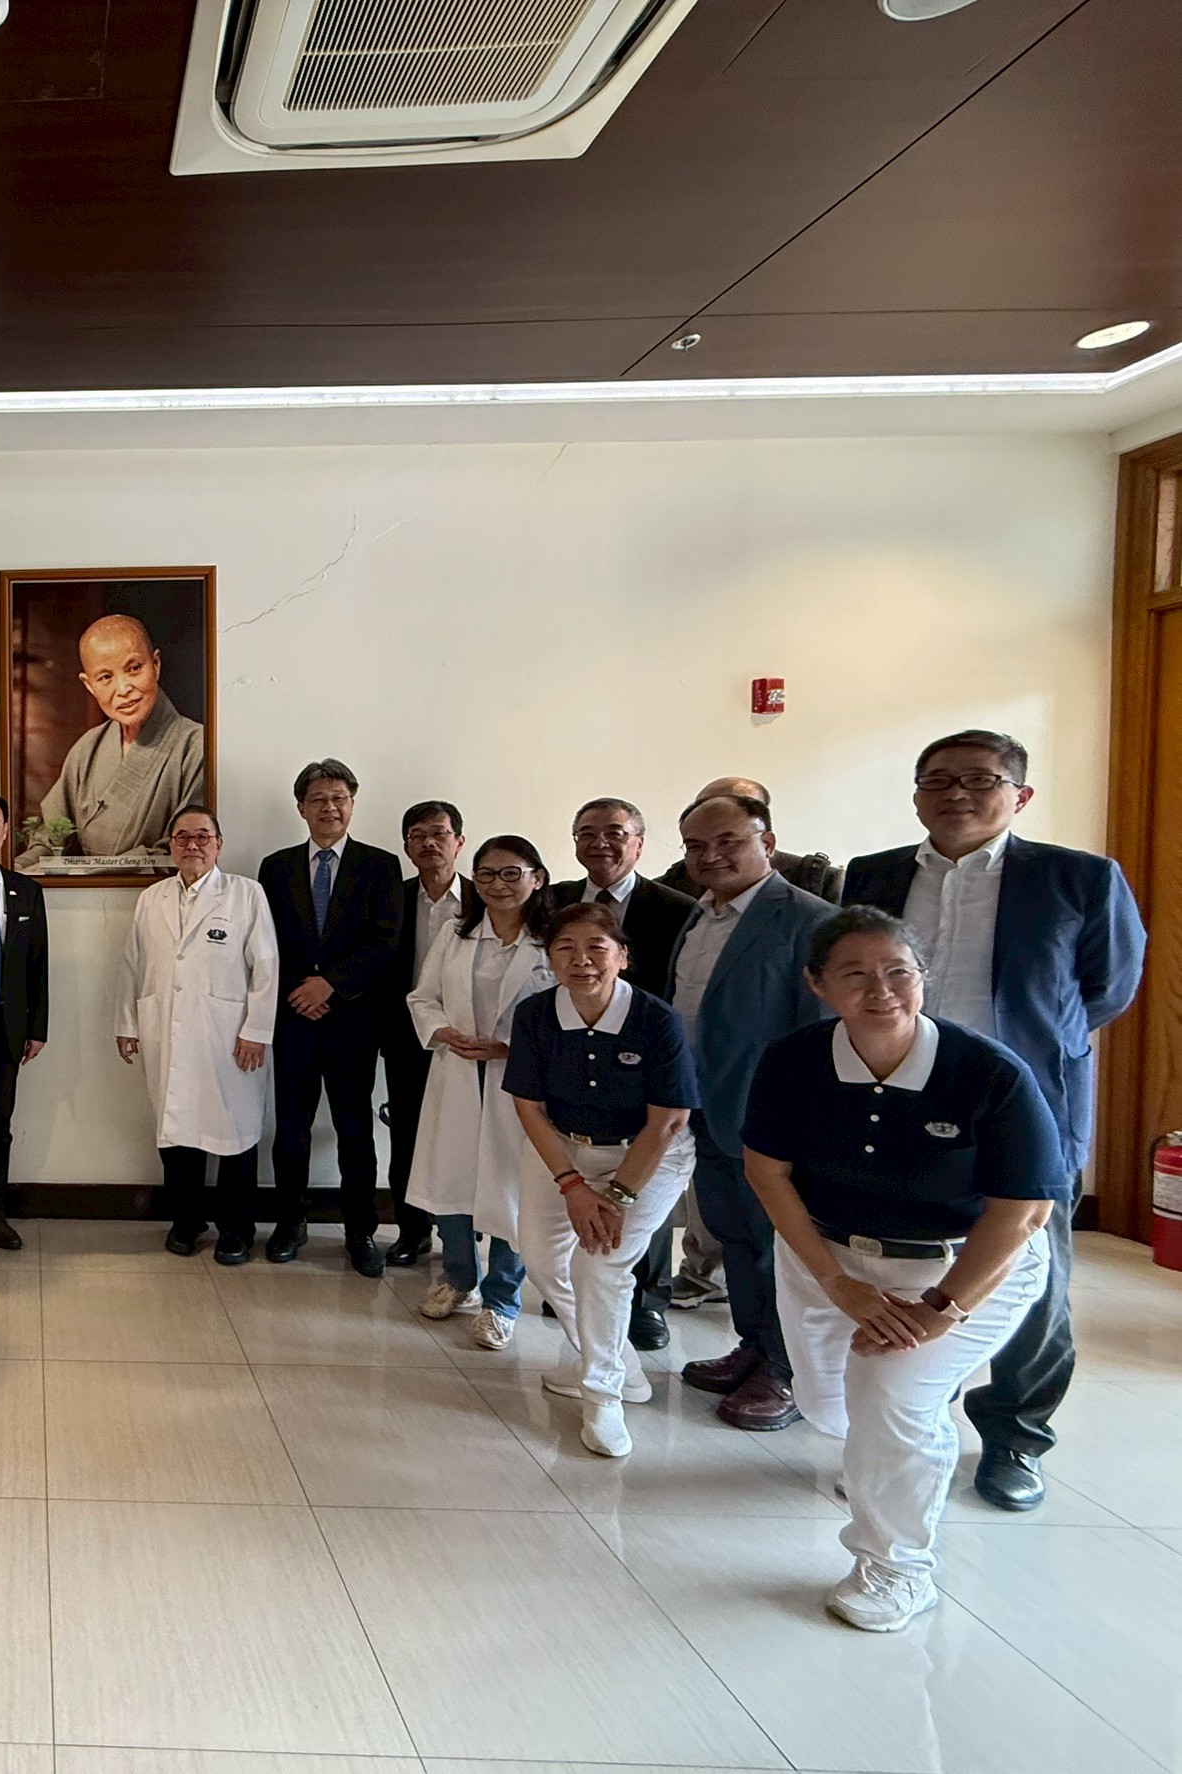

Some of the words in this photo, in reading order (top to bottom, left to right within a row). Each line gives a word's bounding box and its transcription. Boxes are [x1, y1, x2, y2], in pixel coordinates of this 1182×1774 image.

[63, 857, 91, 866] Dharma
[93, 857, 118, 866] Master
[118, 857, 140, 867] Cheng
[142, 857, 156, 866] Yen
